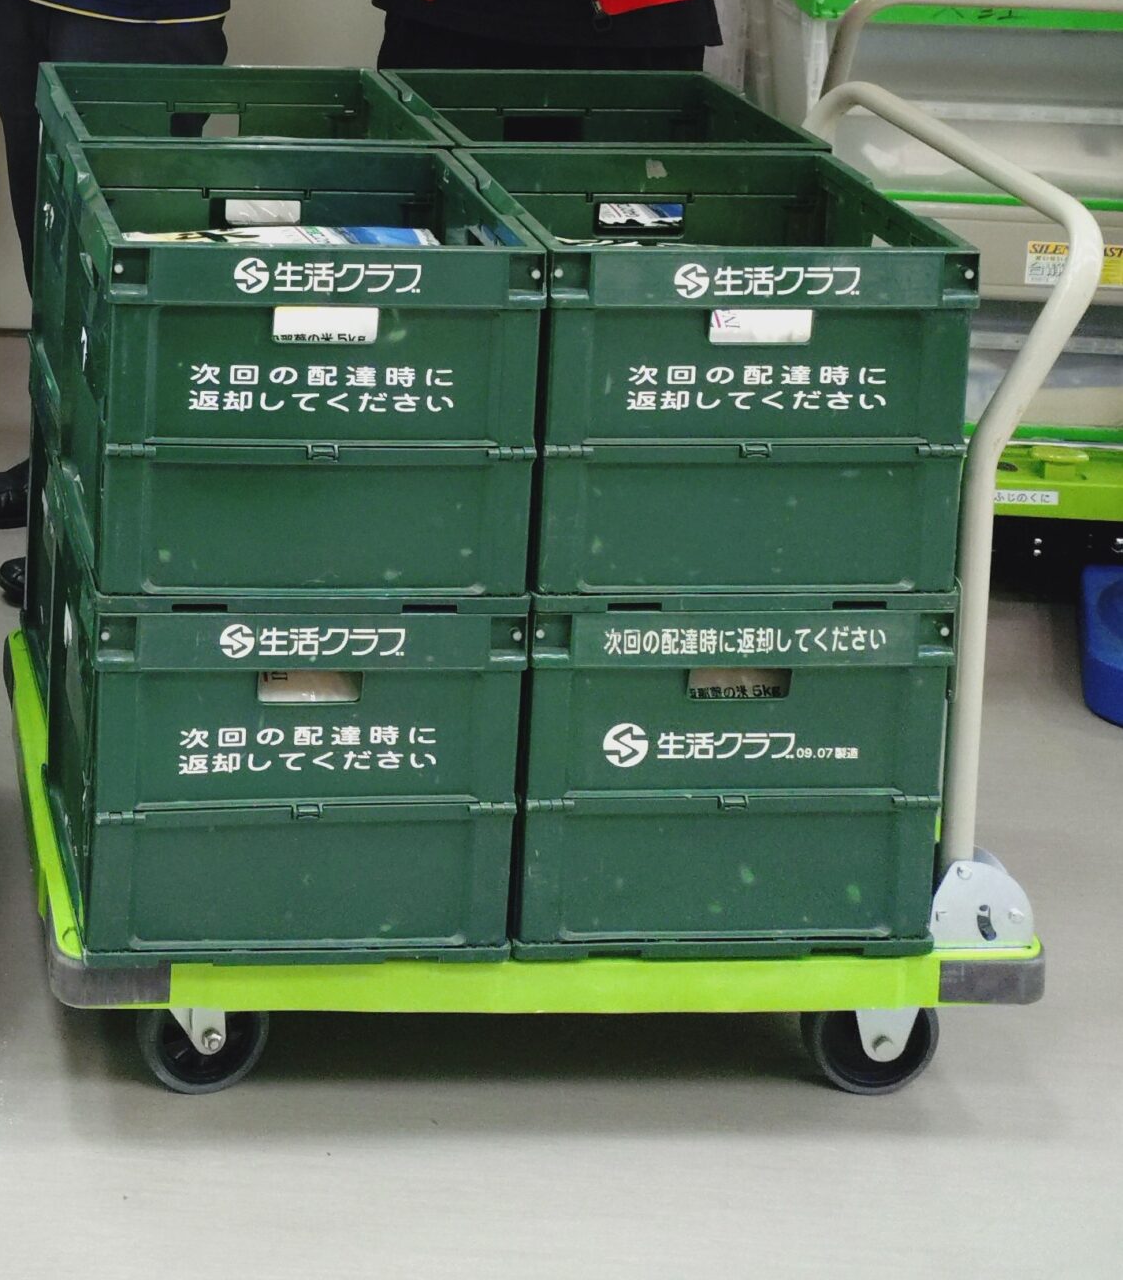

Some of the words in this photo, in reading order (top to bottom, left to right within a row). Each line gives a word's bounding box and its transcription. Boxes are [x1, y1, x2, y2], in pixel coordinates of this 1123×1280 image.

[273, 261, 422, 293] 生活クラブ
[713, 266, 862, 296] 生活クラブ
[189, 364, 455, 387] 次回の配達時に
[628, 365, 887, 387] 次回の配達時に
[188, 389, 455, 413] 返却してください
[627, 389, 887, 411] 返却してください
[257, 627, 406, 657] 生活クラブ
[603, 626, 887, 655] 次回の配達時に返却してください
[179, 726, 437, 748] 次回の配達時に
[656, 731, 795, 760] 生活クラブ
[796, 747, 860, 760] 09.07製造
[178, 750, 437, 776] 返却してください
